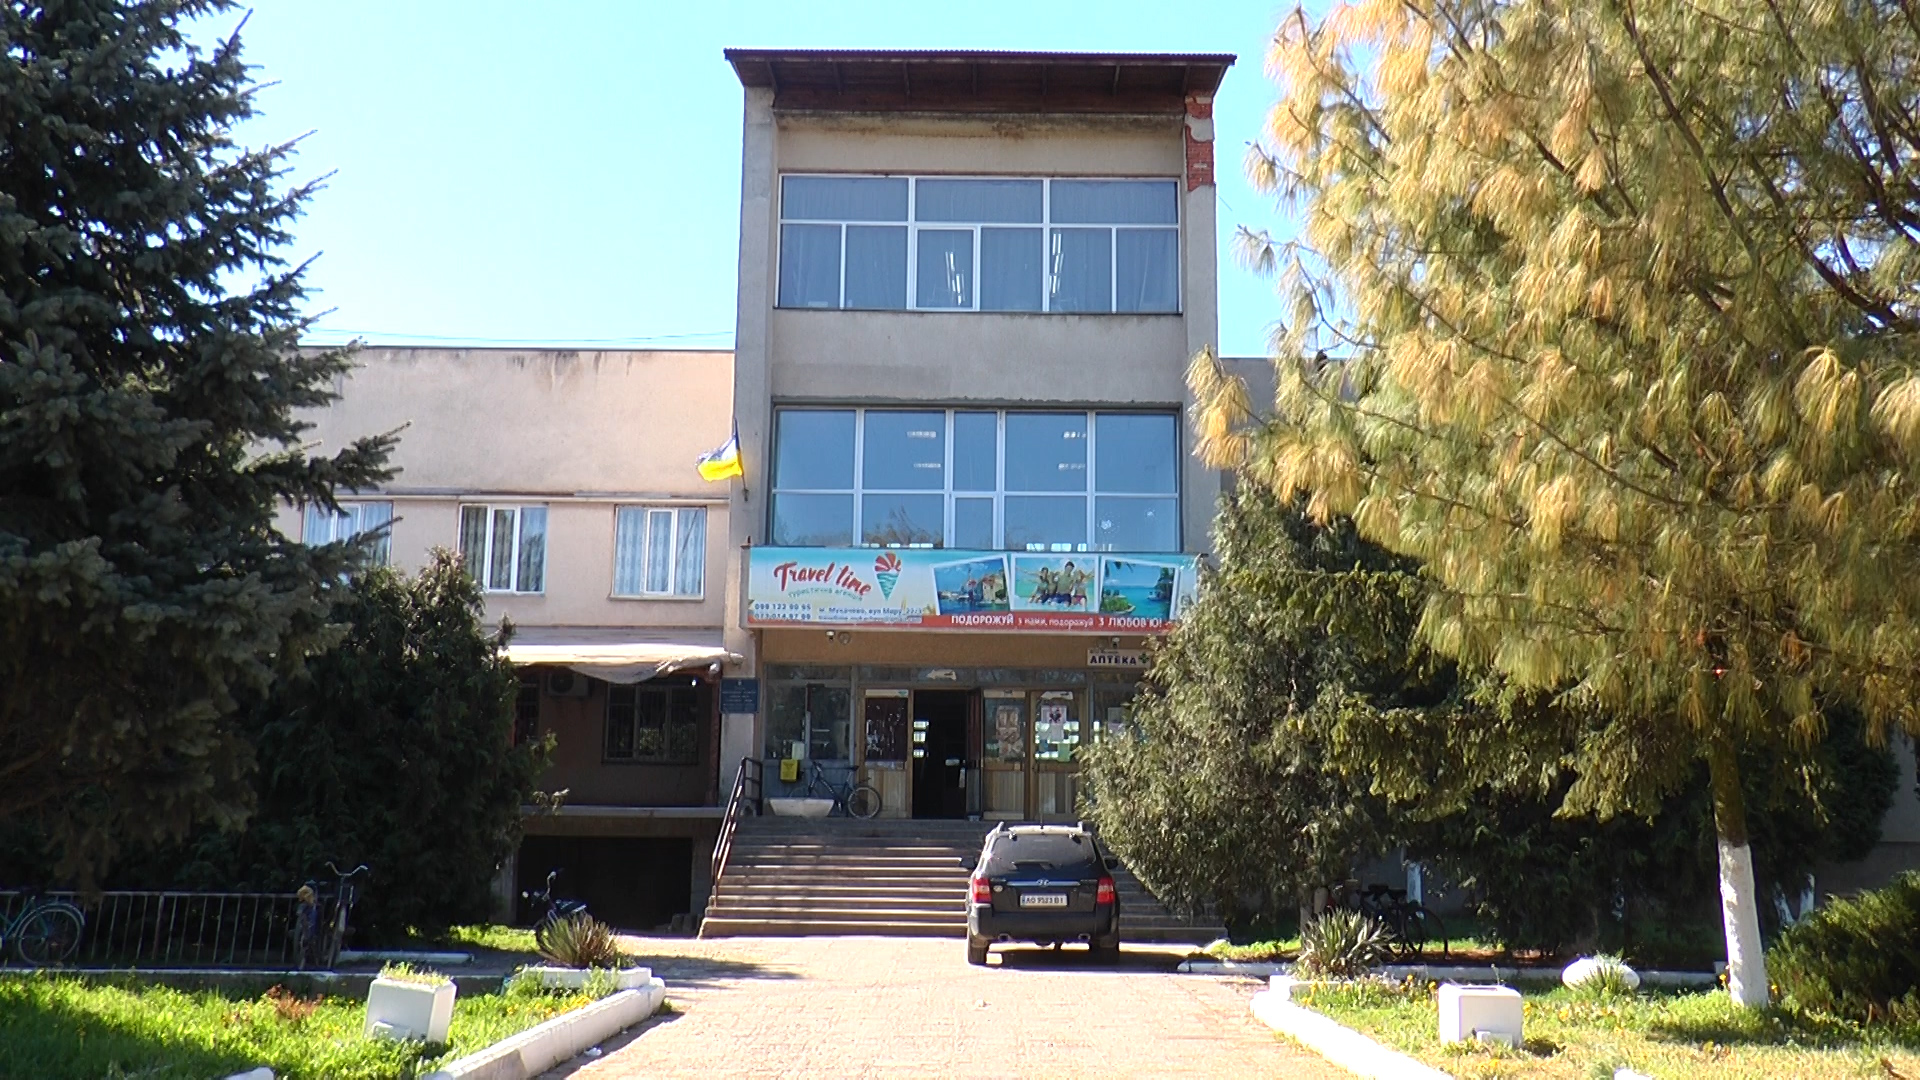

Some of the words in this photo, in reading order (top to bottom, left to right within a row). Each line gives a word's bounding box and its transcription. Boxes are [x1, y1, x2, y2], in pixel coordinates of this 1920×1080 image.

[774, 561, 835, 591] Travel
[951, 613, 1014, 625] ПОДОРОЖУЙ
[1049, 618, 1094, 630] подорожуй
[1090, 655, 1136, 665] АПТЕКА
